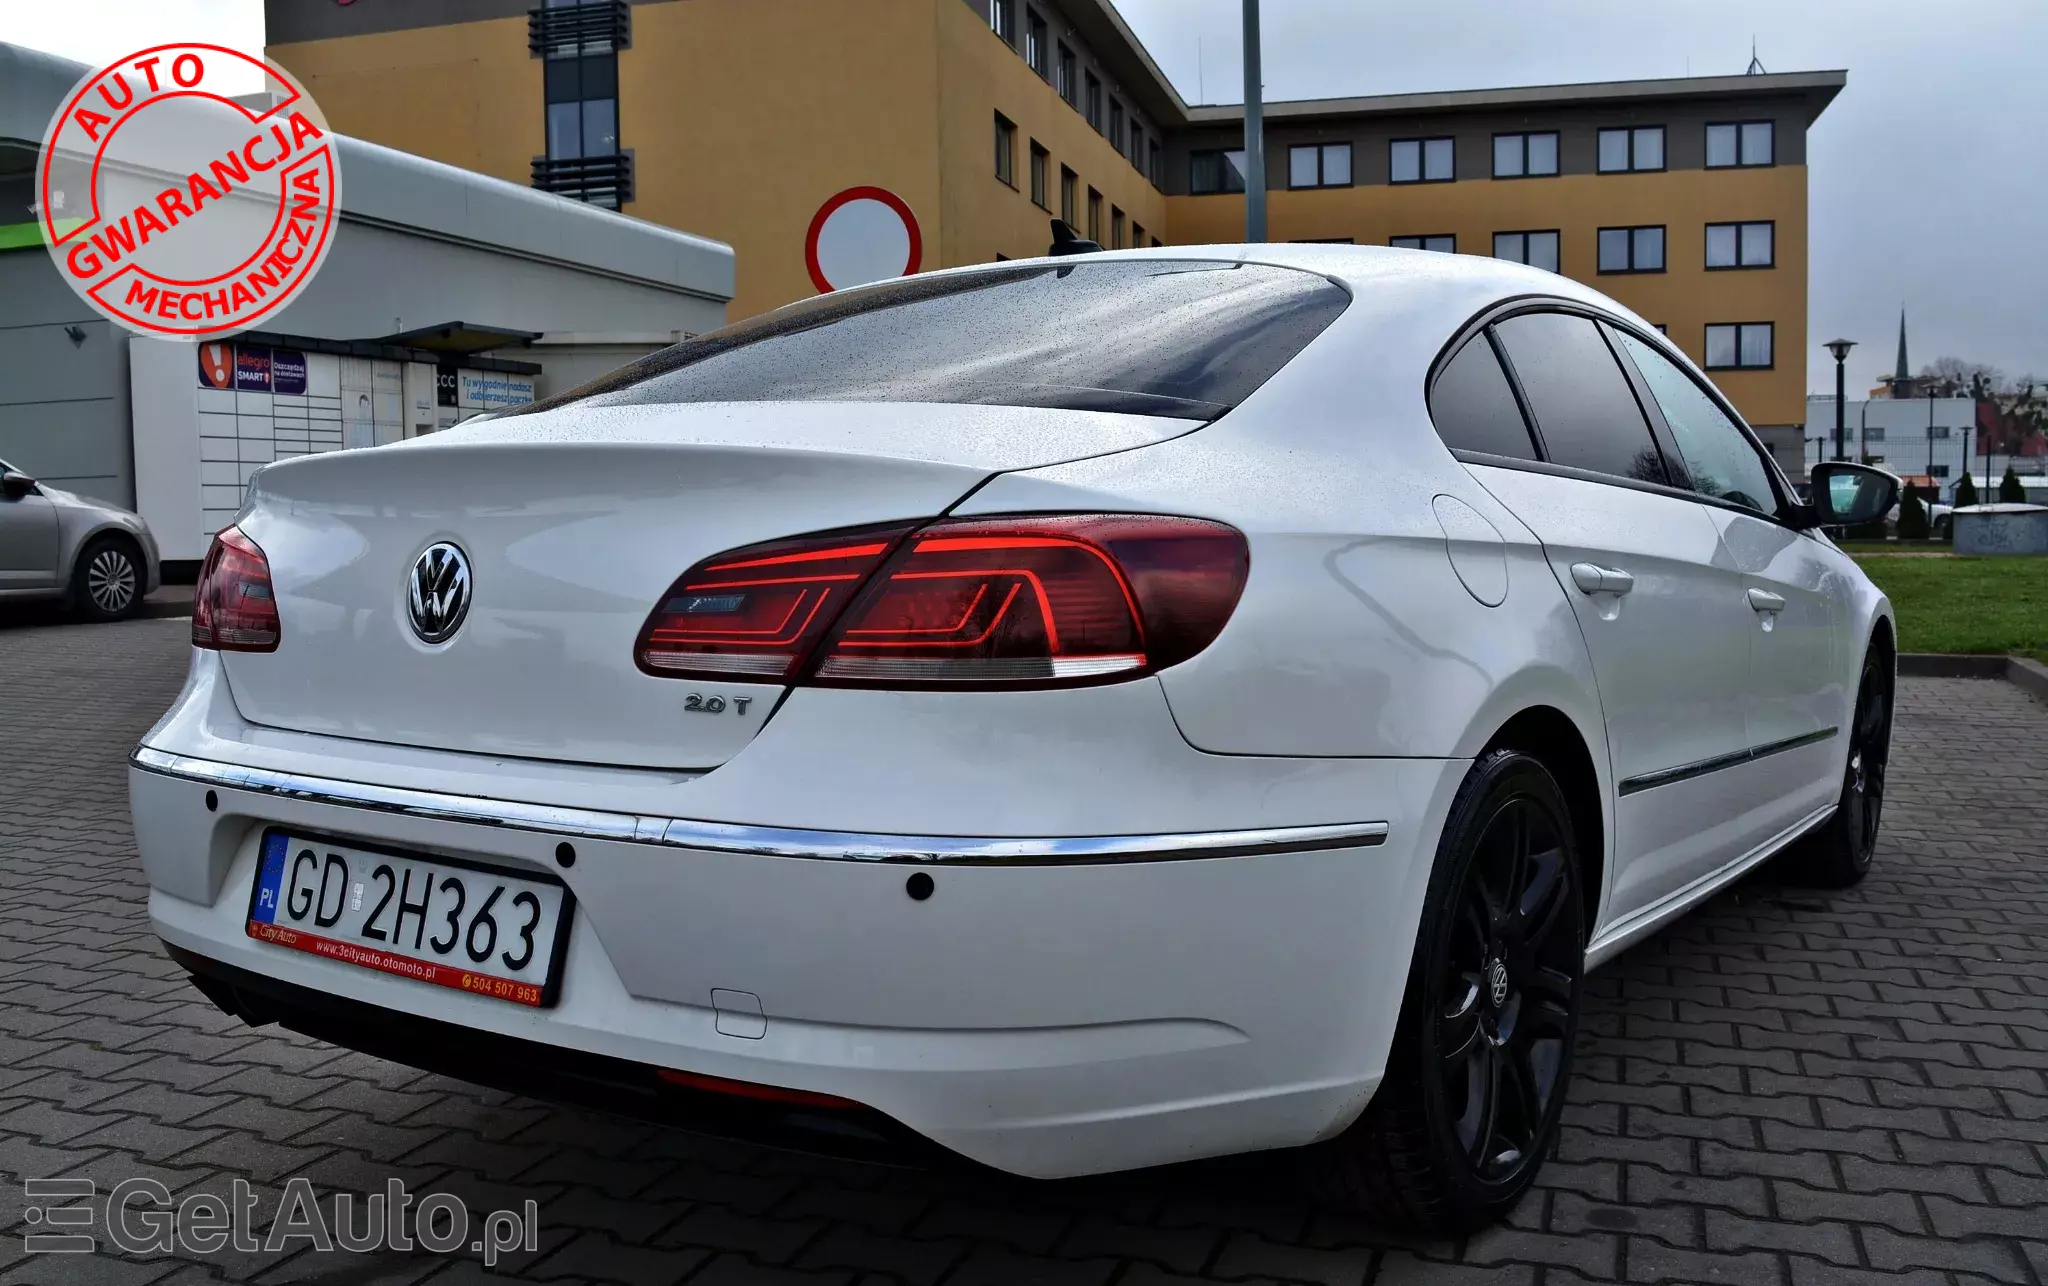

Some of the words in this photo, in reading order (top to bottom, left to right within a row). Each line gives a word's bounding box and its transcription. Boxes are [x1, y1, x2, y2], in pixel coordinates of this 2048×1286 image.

[237, 353, 270, 370] allegro
[462, 376, 471, 387] Tu
[684, 692, 726, 714] 2.0
[733, 696, 752, 716] T
[260, 887, 274, 909] PL
[286, 848, 349, 928] GD
[361, 864, 541, 972] 2H363
[260, 925, 278, 941] City
[277, 929, 297, 944] Auto
[316, 941, 436, 979] www.3cityauto.otomoto.pl
[472, 977, 492, 992] 504
[494, 982, 514, 996] 507
[517, 986, 538, 1002] 963
